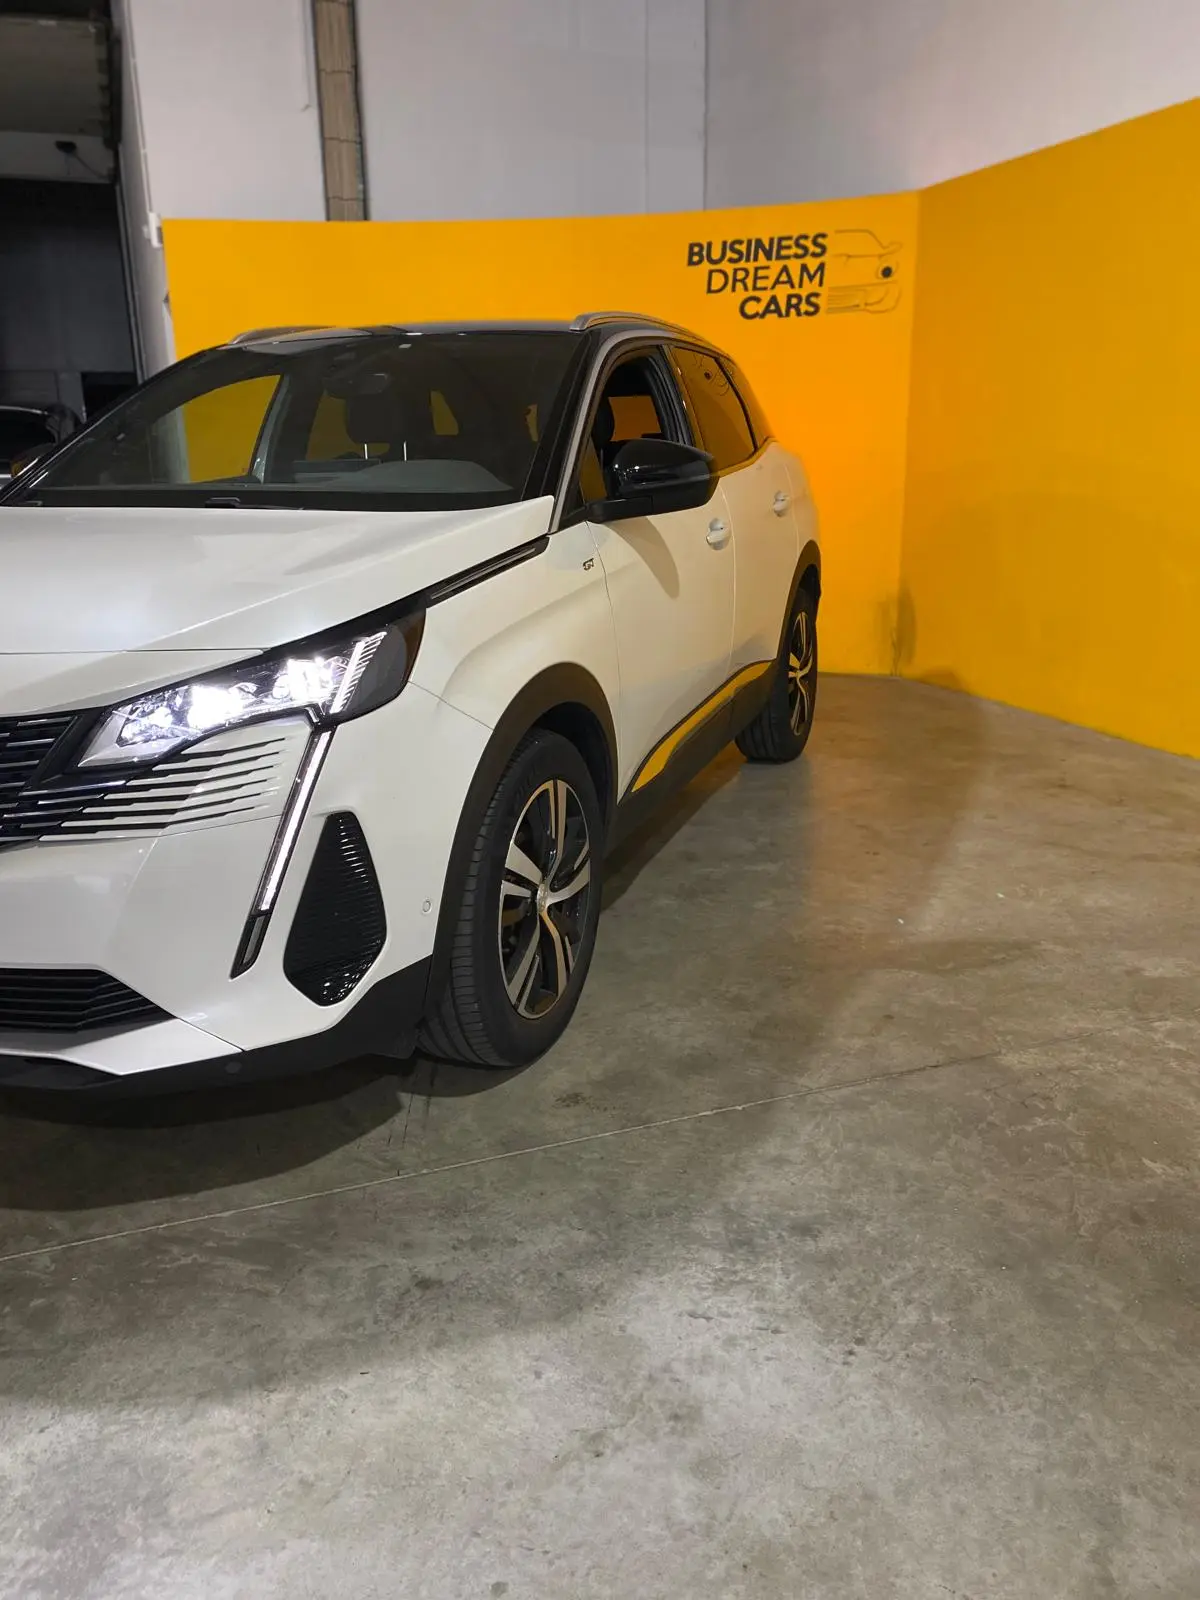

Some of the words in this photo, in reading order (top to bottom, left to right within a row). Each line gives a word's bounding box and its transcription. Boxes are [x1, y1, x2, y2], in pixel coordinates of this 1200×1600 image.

[687, 233, 828, 266] BUSINESS
[706, 262, 825, 294] DREAM
[739, 292, 821, 320] CARS
